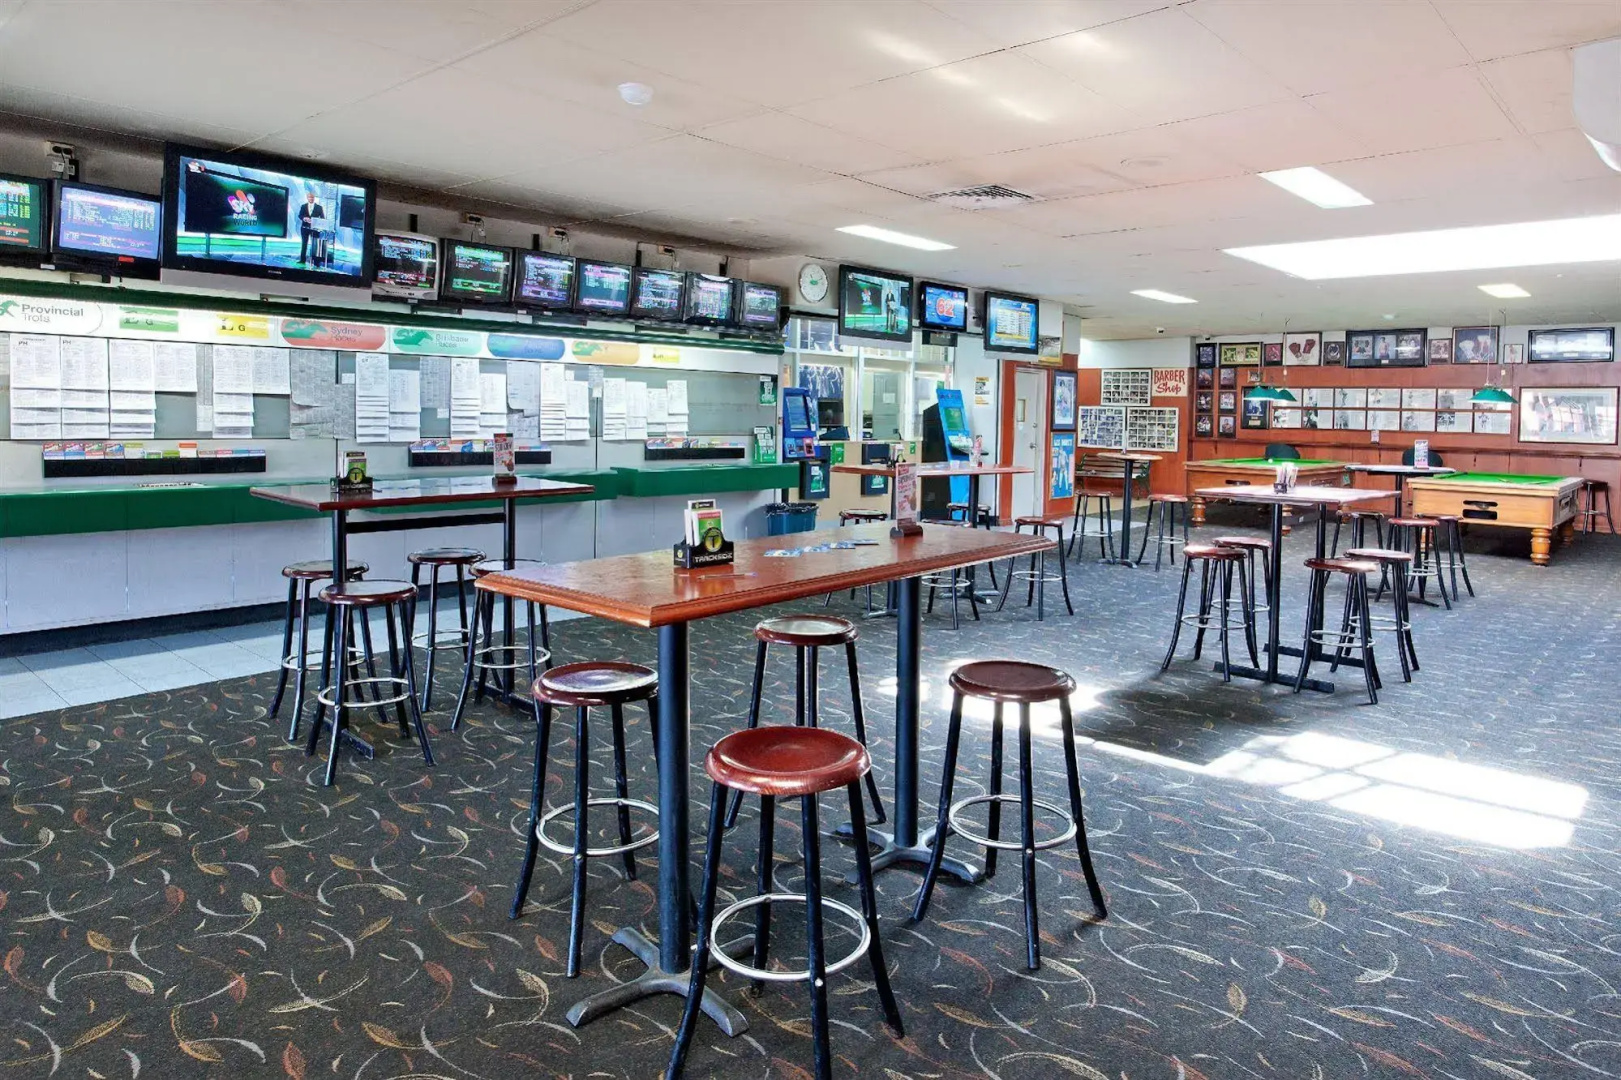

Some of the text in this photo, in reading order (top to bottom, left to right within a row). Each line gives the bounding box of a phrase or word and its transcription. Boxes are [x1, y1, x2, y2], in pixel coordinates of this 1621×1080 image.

[21, 303, 84, 317] Provincial
[936, 298, 955, 317] 62
[22, 312, 51, 323] Trots
[238, 324, 246, 332] G
[331, 326, 363, 337] Sydney
[1153, 369, 1186, 385] BARBER
[1155, 382, 1182, 395] Shop
[694, 552, 733, 563] TRACKSIDE
